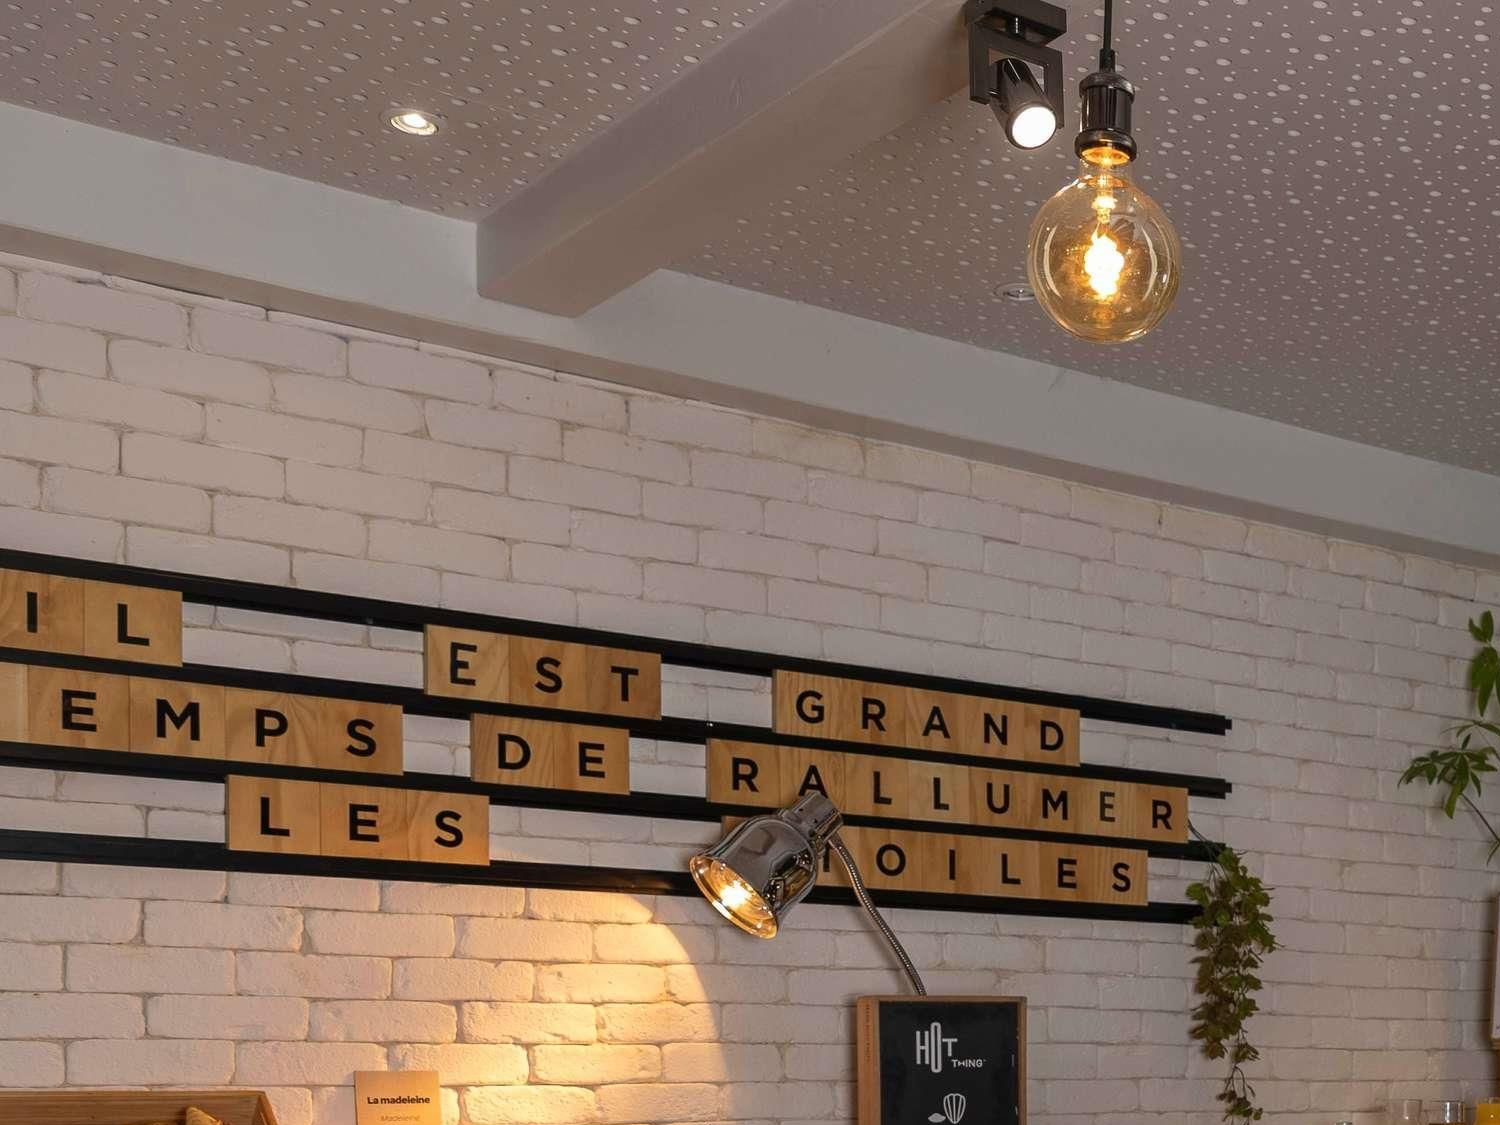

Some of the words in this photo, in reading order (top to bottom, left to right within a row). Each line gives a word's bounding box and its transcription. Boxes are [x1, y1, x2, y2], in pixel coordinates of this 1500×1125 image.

[26, 591, 150, 647] IL
[449, 642, 639, 702] EST
[795, 689, 1065, 752] GRAND
[61, 688, 377, 758] EMPS
[497, 733, 606, 779] DE
[731, 757, 1172, 830] RALLUMER
[259, 796, 464, 849] LES
[822, 840, 1132, 895] OILES
[916, 1021, 958, 1073] HOT
[951, 1059, 983, 1068] THING
[367, 1096, 379, 1104] La
[380, 1095, 431, 1104] madeleine
